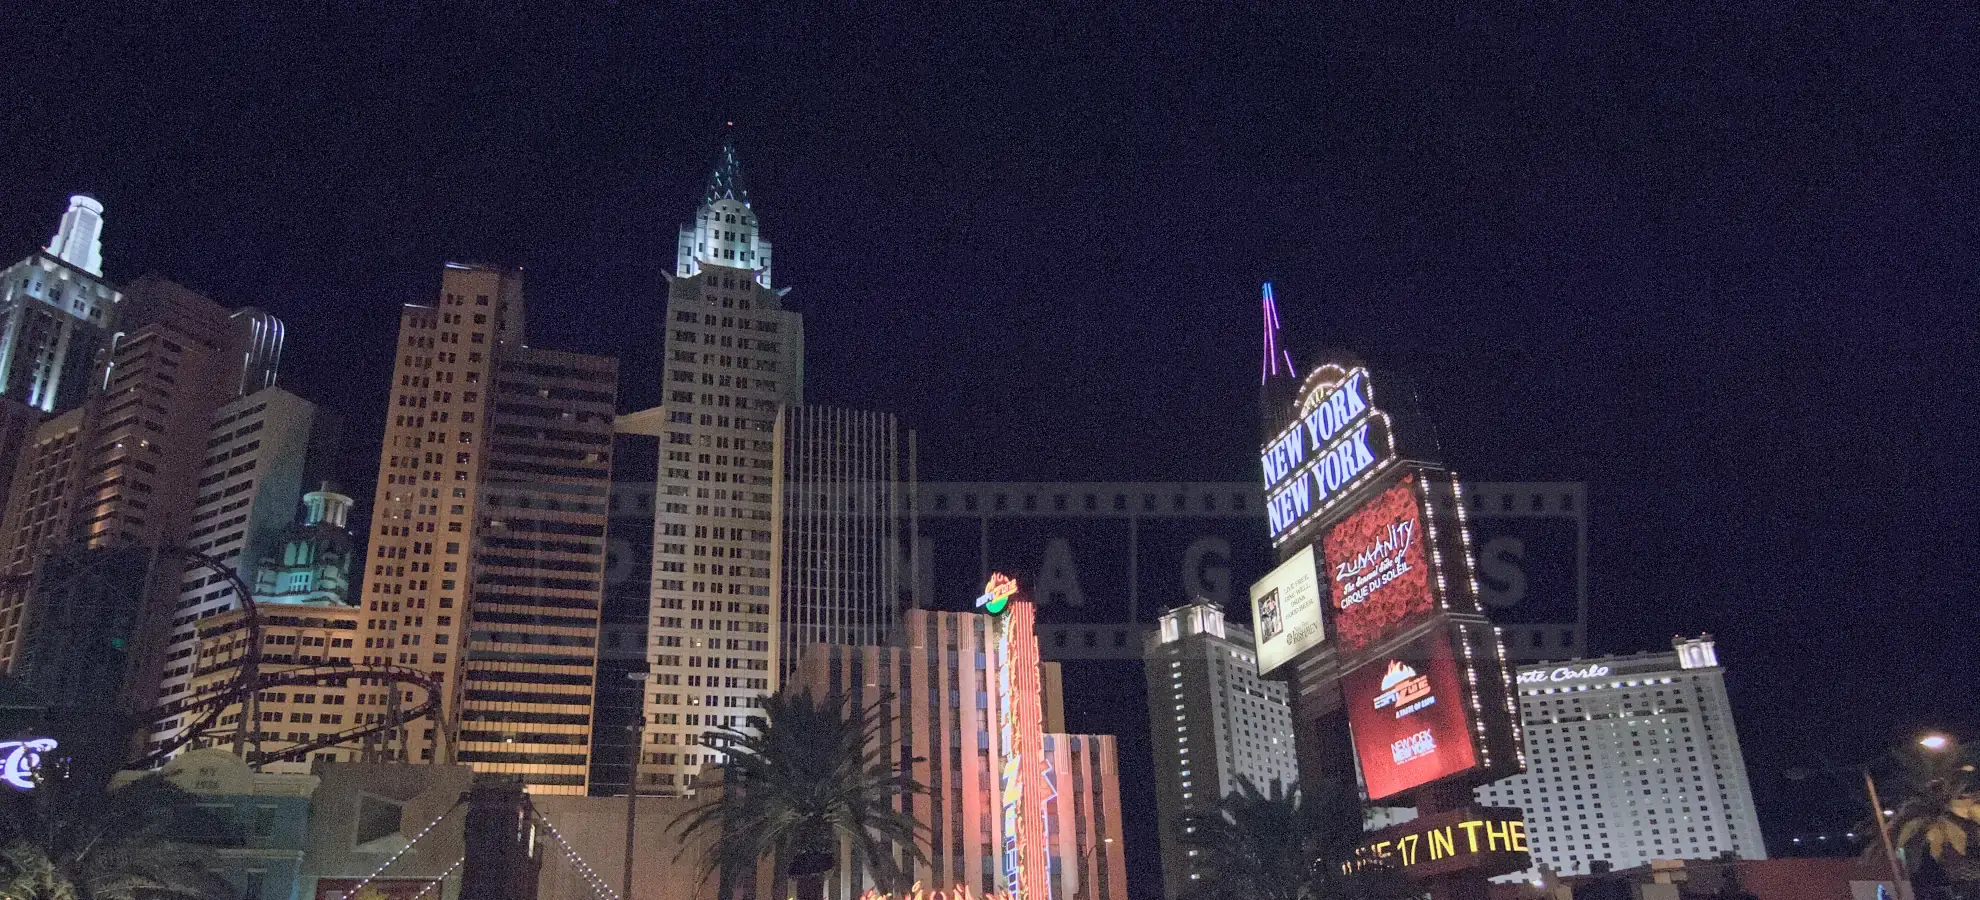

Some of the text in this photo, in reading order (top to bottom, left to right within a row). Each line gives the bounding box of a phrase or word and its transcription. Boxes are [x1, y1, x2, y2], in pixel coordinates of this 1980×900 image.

[1261, 372, 1366, 491] NEW YORK
[1267, 424, 1375, 538] NEW YORK
[1336, 518, 1414, 581] ZUMANITY
[1341, 562, 1413, 609] CIRQUE DU SOLEIL
[1550, 664, 1609, 682] Carlo
[1397, 834, 1418, 866] 17
[1427, 826, 1455, 860] IN
[1458, 820, 1529, 853] THE
